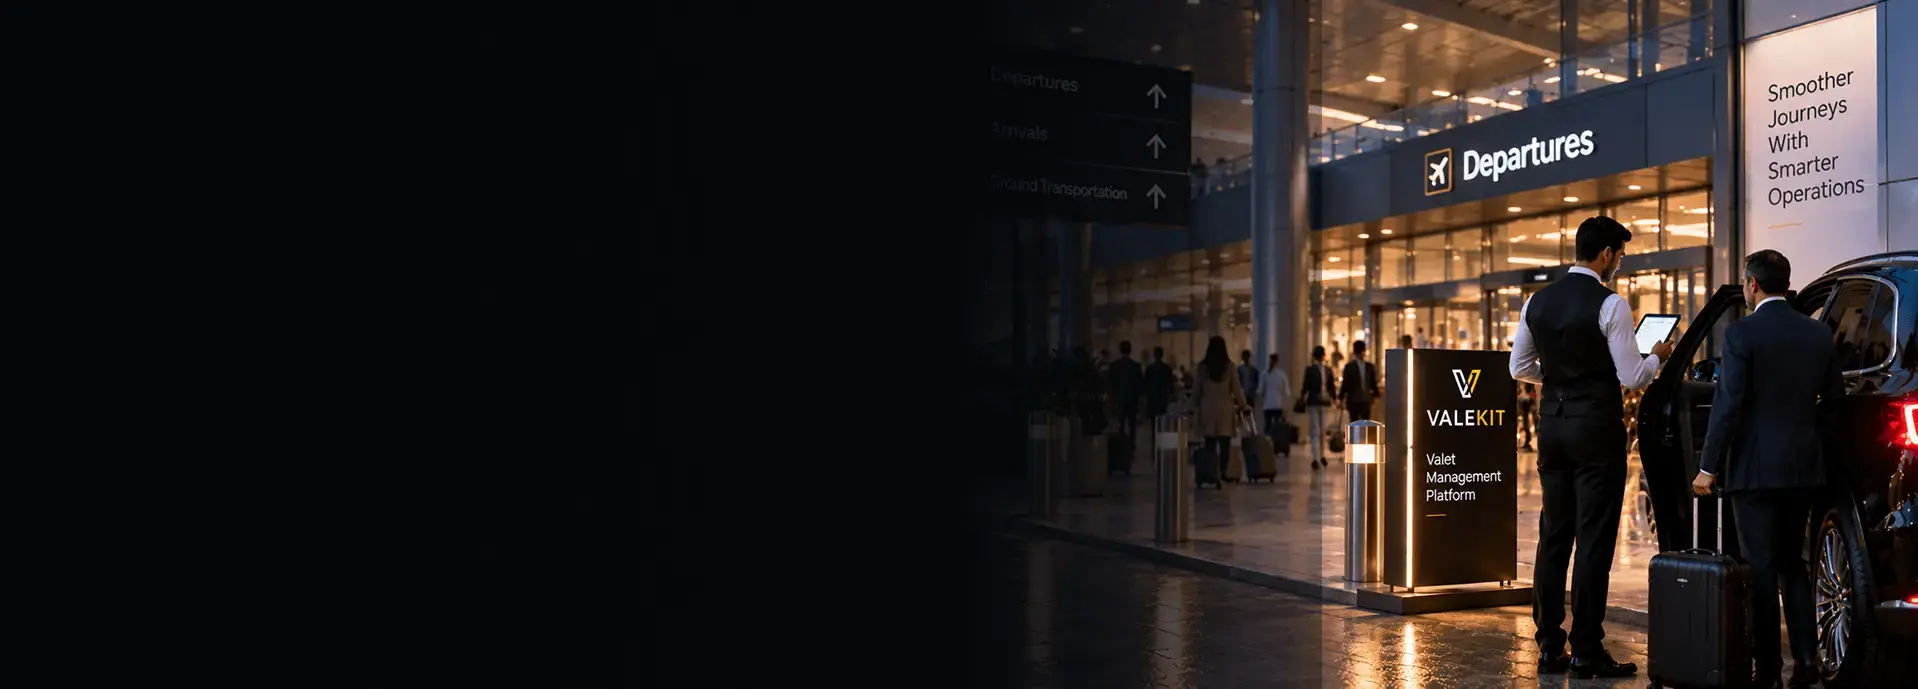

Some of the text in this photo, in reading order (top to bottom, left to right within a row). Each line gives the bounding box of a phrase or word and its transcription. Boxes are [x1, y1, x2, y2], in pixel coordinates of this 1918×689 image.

[989, 66, 1079, 92] Departures
[1768, 71, 1854, 102] Smoother
[1768, 99, 1848, 128] Journeys
[1768, 131, 1809, 153] With
[1463, 130, 1595, 182] Departures
[1768, 156, 1839, 180] Smarter
[1040, 177, 1128, 200] Transportation
[1768, 179, 1865, 208] Operations
[1426, 410, 1506, 426] VALEKIT
[1426, 453, 1456, 466] Valet
[1426, 470, 1502, 485] Management
[1426, 488, 1476, 501] Platform
